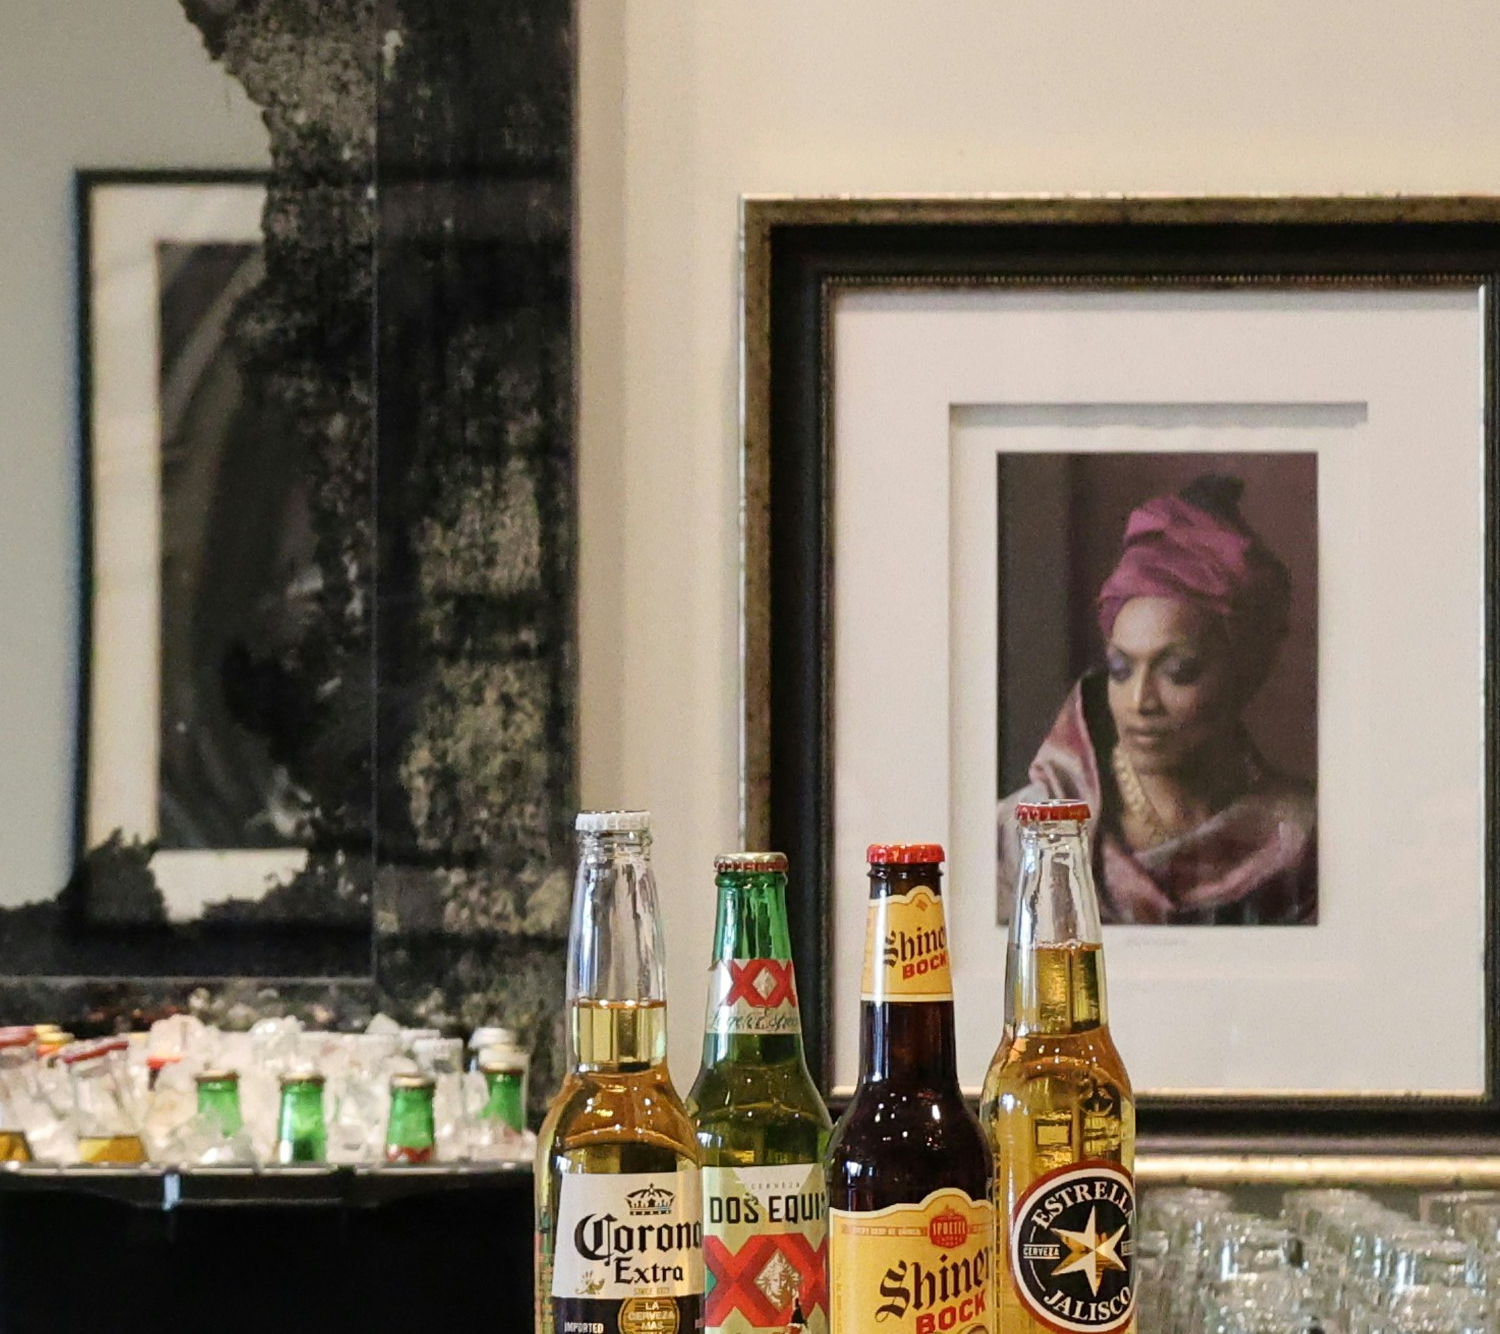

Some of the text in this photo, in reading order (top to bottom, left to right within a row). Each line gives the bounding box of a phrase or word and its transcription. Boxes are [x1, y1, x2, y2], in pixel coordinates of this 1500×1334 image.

[902, 954, 949, 980] BOCK
[710, 1195, 760, 1224] DOS
[1023, 1247, 1060, 1257] CERVEZA
[614, 1256, 684, 1285] Extra
[645, 1302, 660, 1311] LA
[1044, 1286, 1131, 1321] JALISCO
[628, 1311, 676, 1322] CERVEZA
[564, 1322, 604, 1334] IMPORTED
